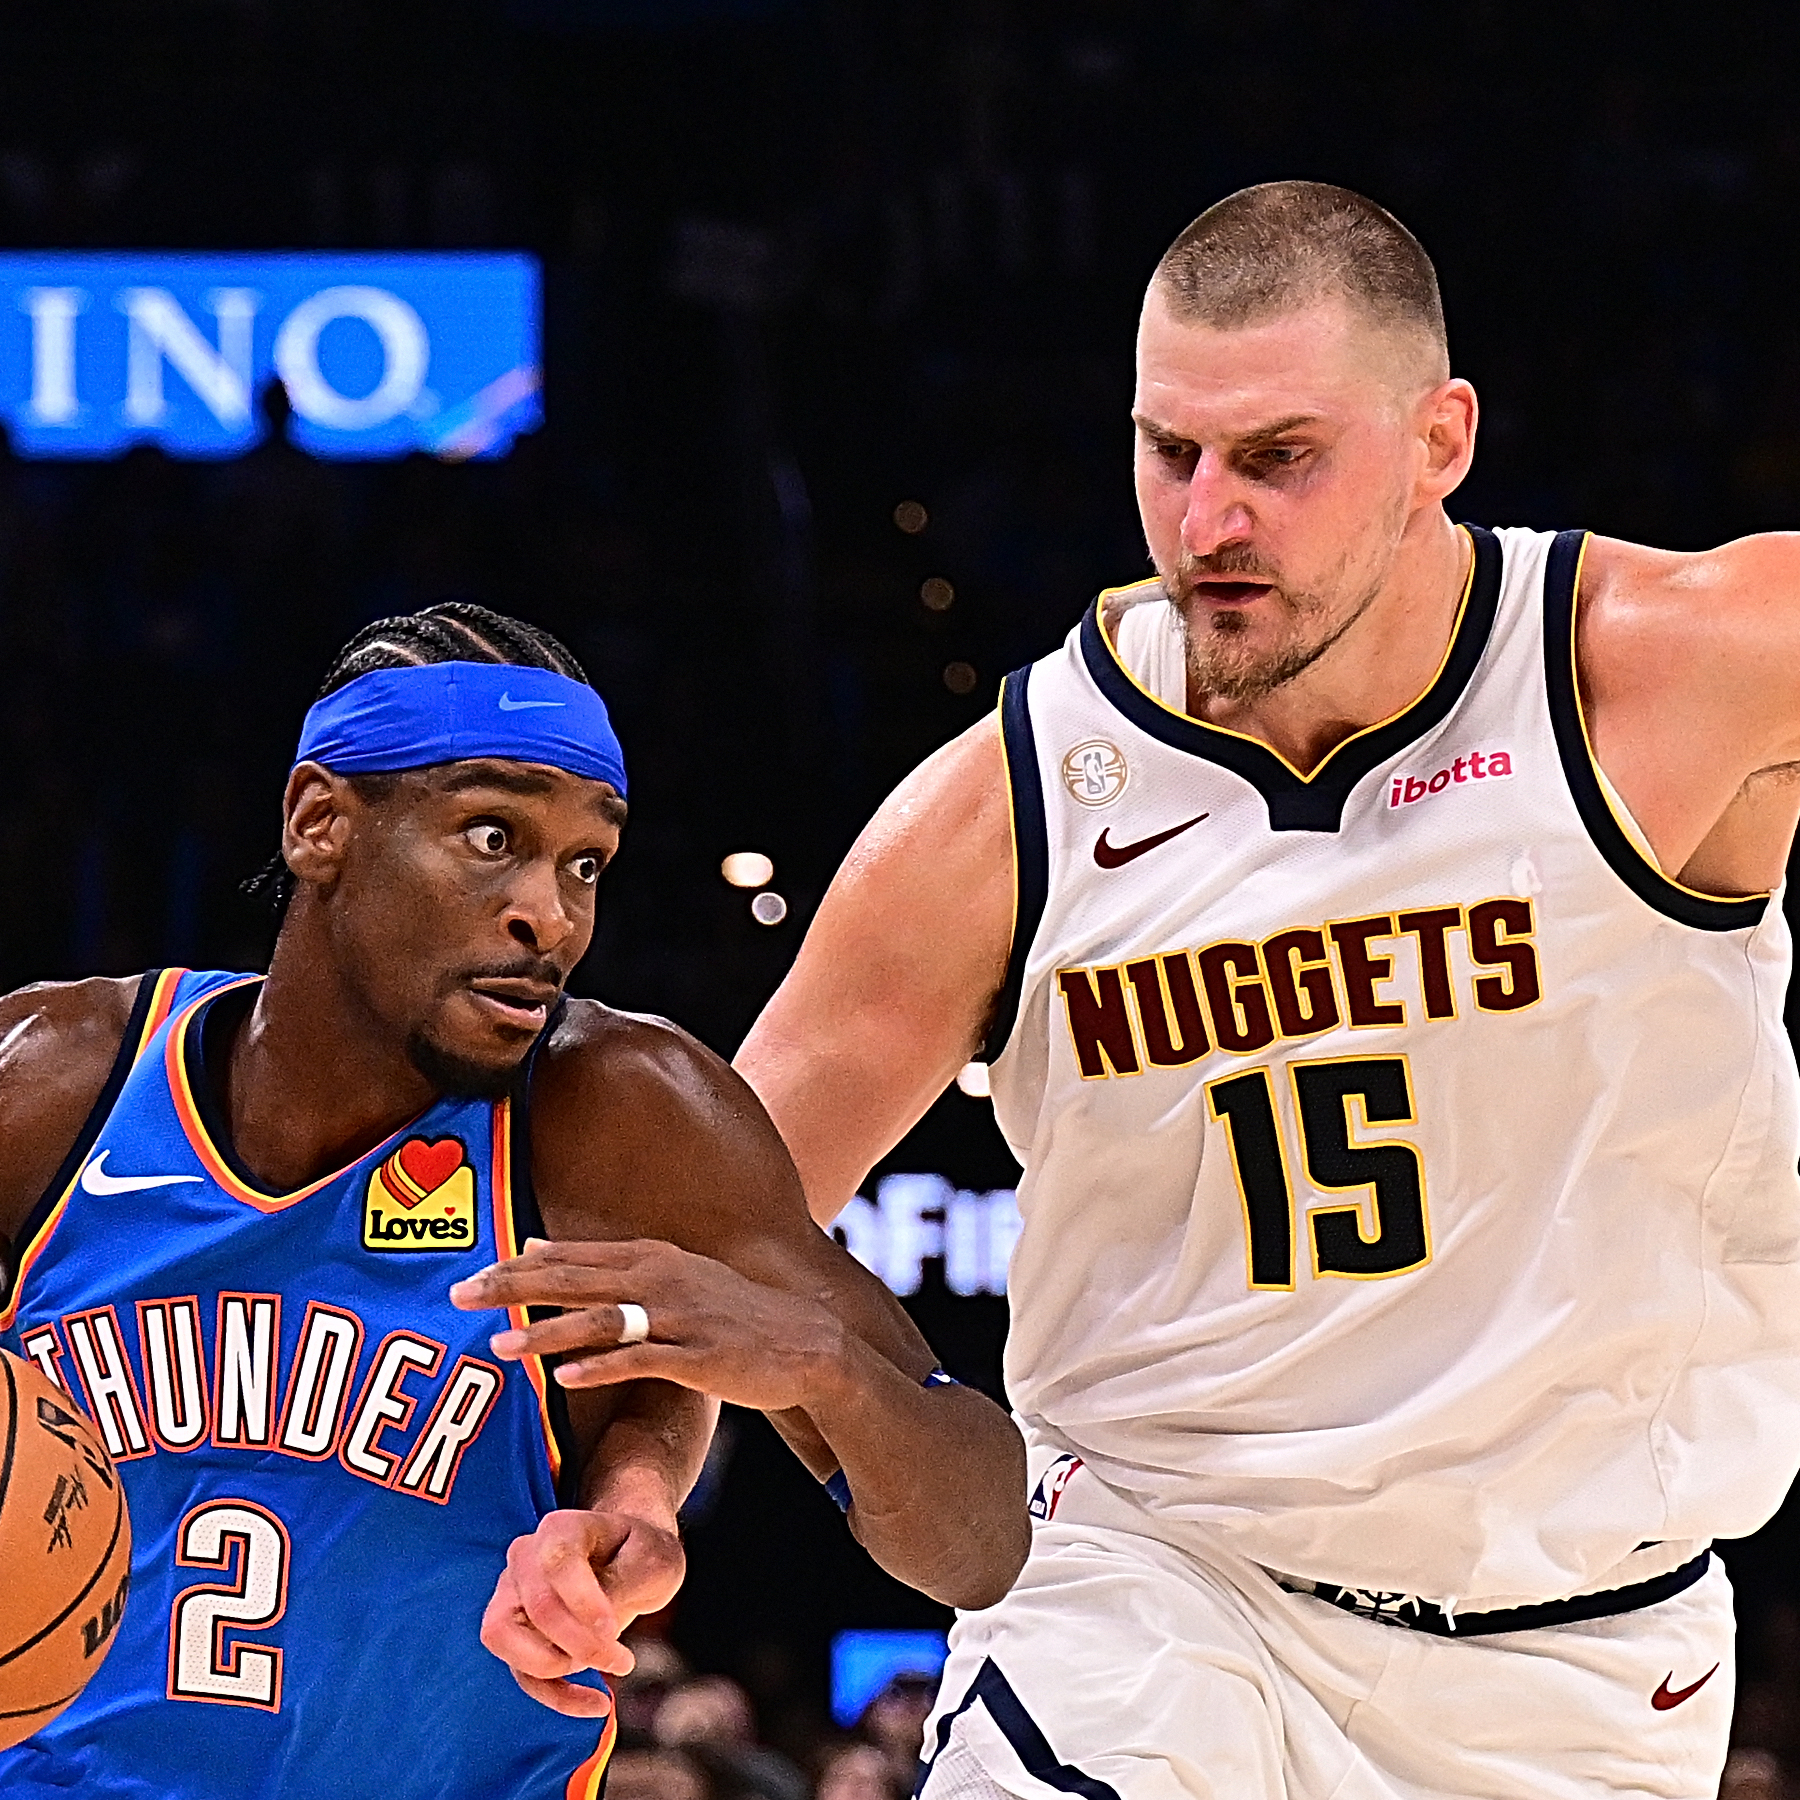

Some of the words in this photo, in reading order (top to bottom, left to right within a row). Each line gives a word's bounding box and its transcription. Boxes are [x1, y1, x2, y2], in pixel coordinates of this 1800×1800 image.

[1390, 751, 1513, 808] ibotta
[1056, 896, 1542, 1081] NUGGETS
[1204, 1053, 1433, 1292] 15
[167, 1499, 290, 1711] 2
